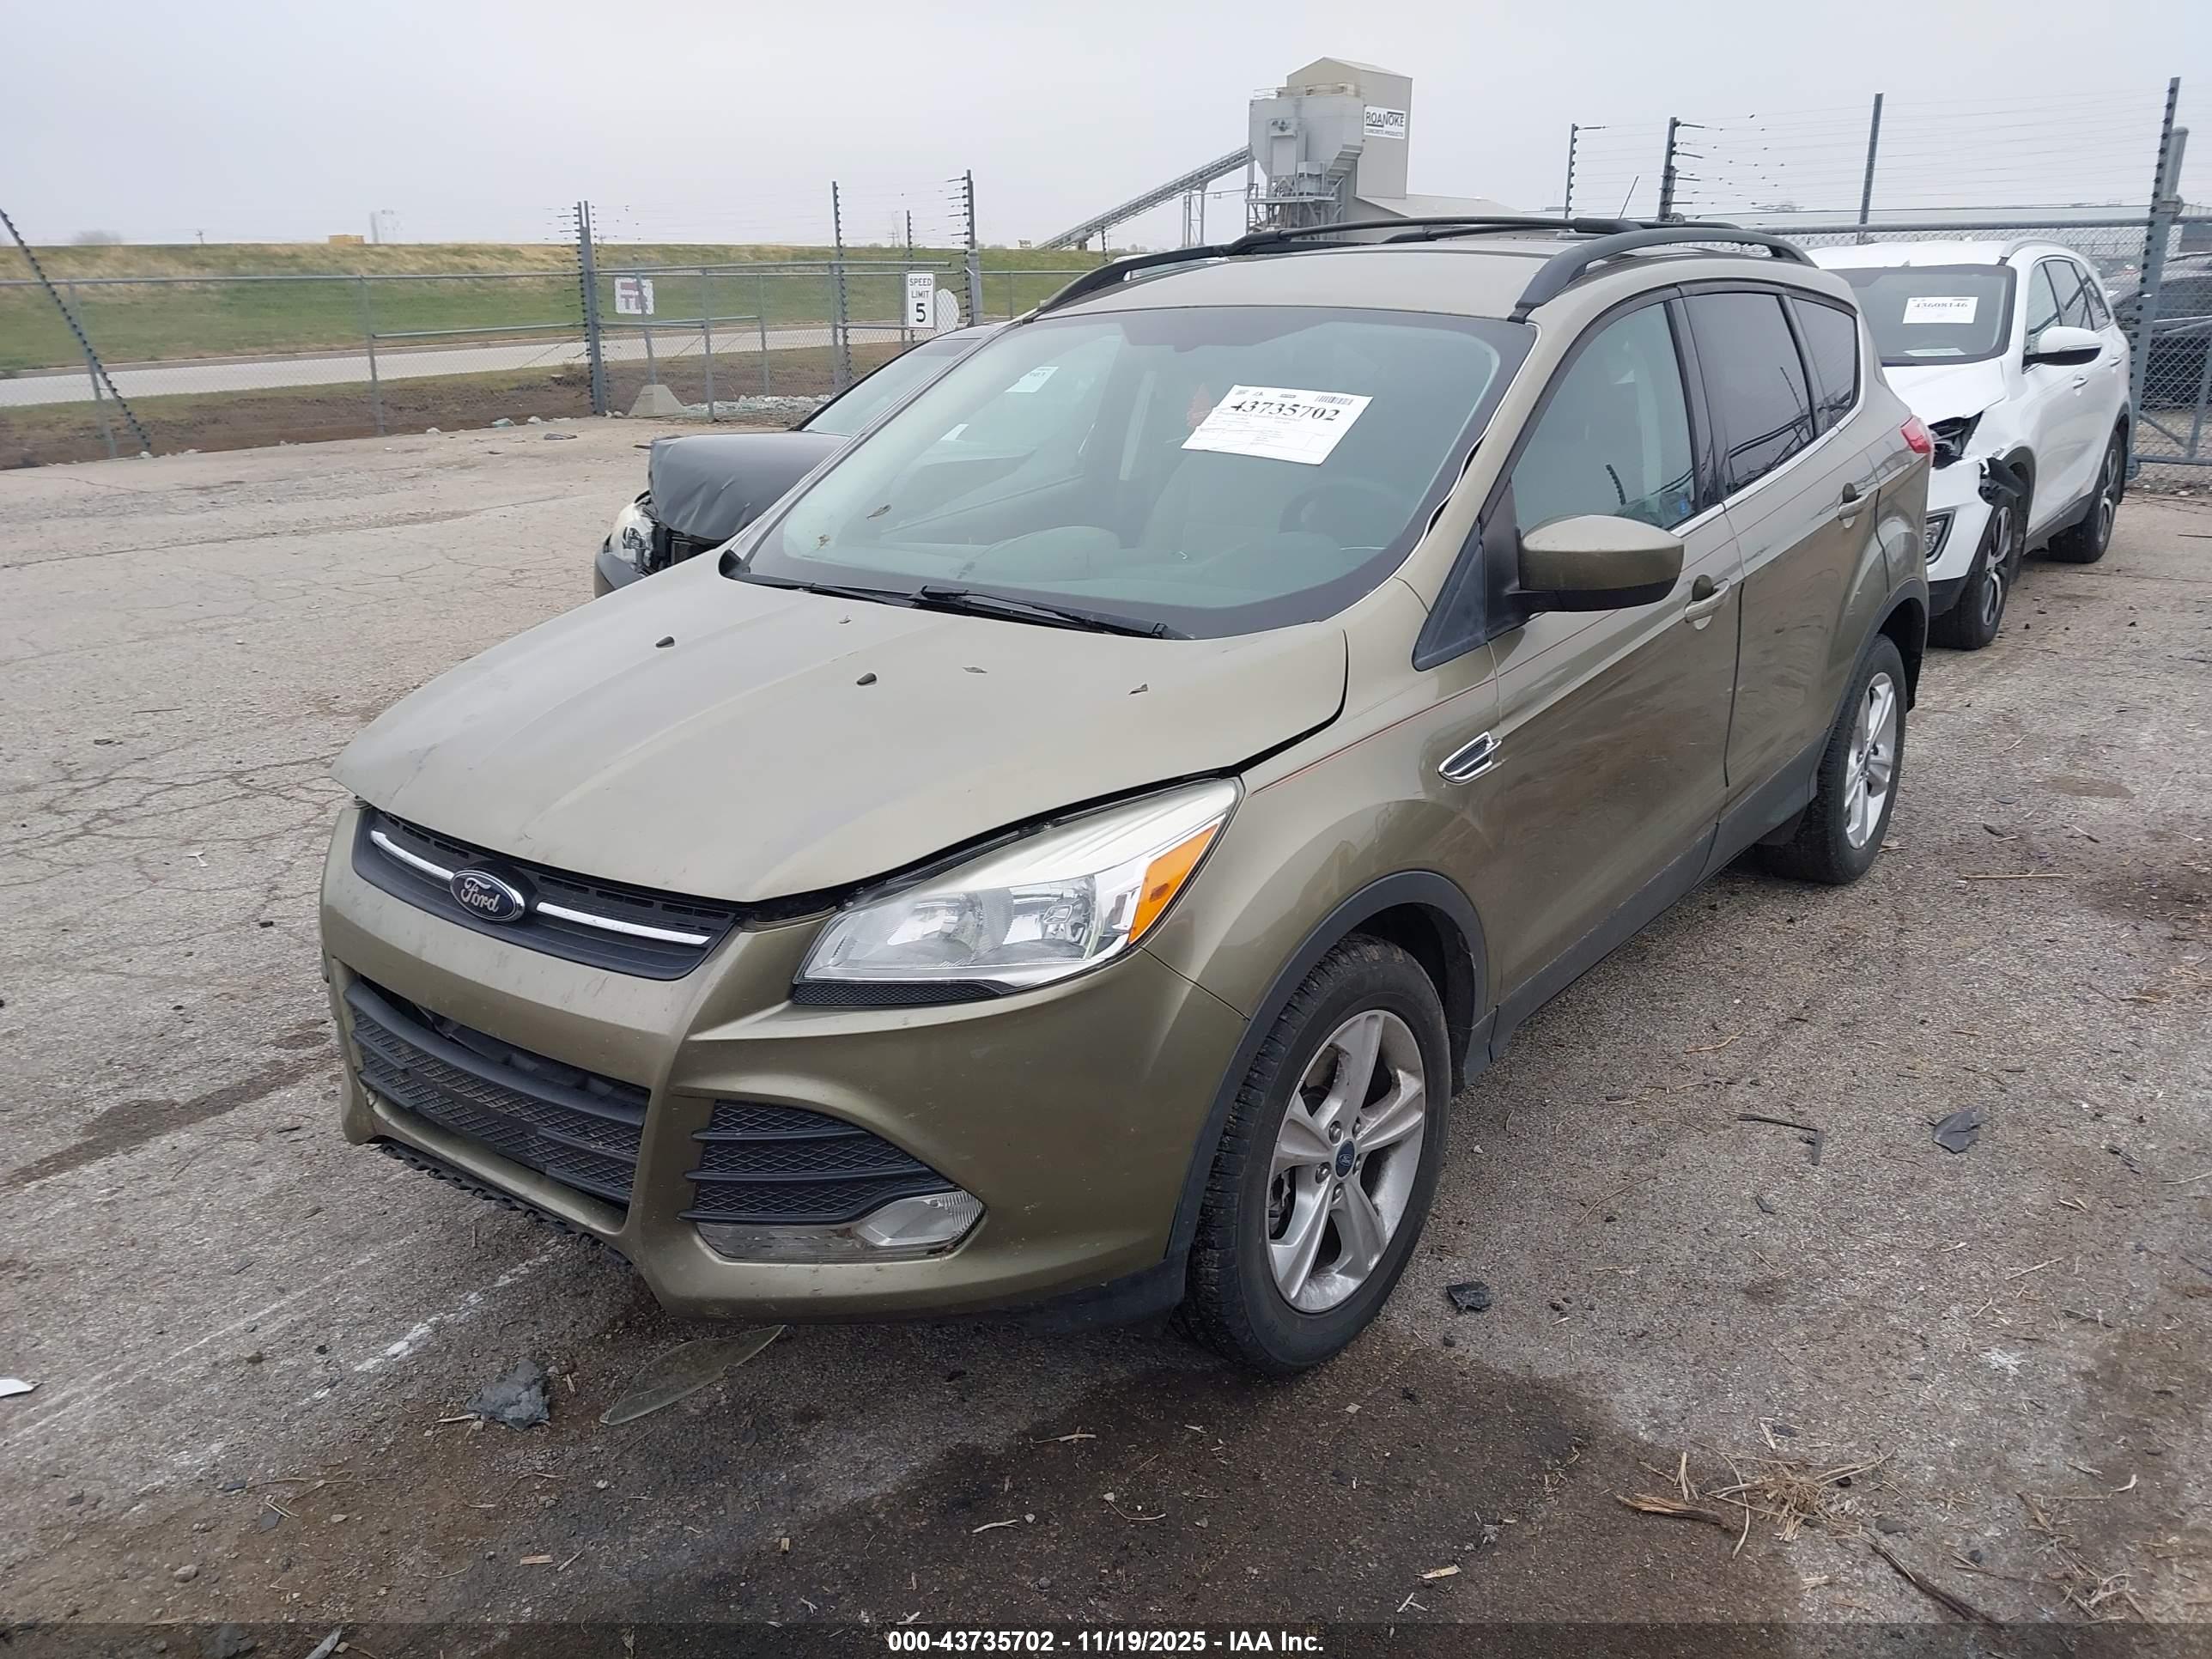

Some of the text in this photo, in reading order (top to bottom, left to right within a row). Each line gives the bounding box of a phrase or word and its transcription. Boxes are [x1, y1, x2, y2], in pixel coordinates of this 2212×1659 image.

[1365, 112, 1405, 127] ROANOKE
[909, 277, 933, 286] SPEED
[915, 302, 927, 323] 5
[1231, 400, 1340, 422] 43735702
[460, 877, 501, 913] Ford
